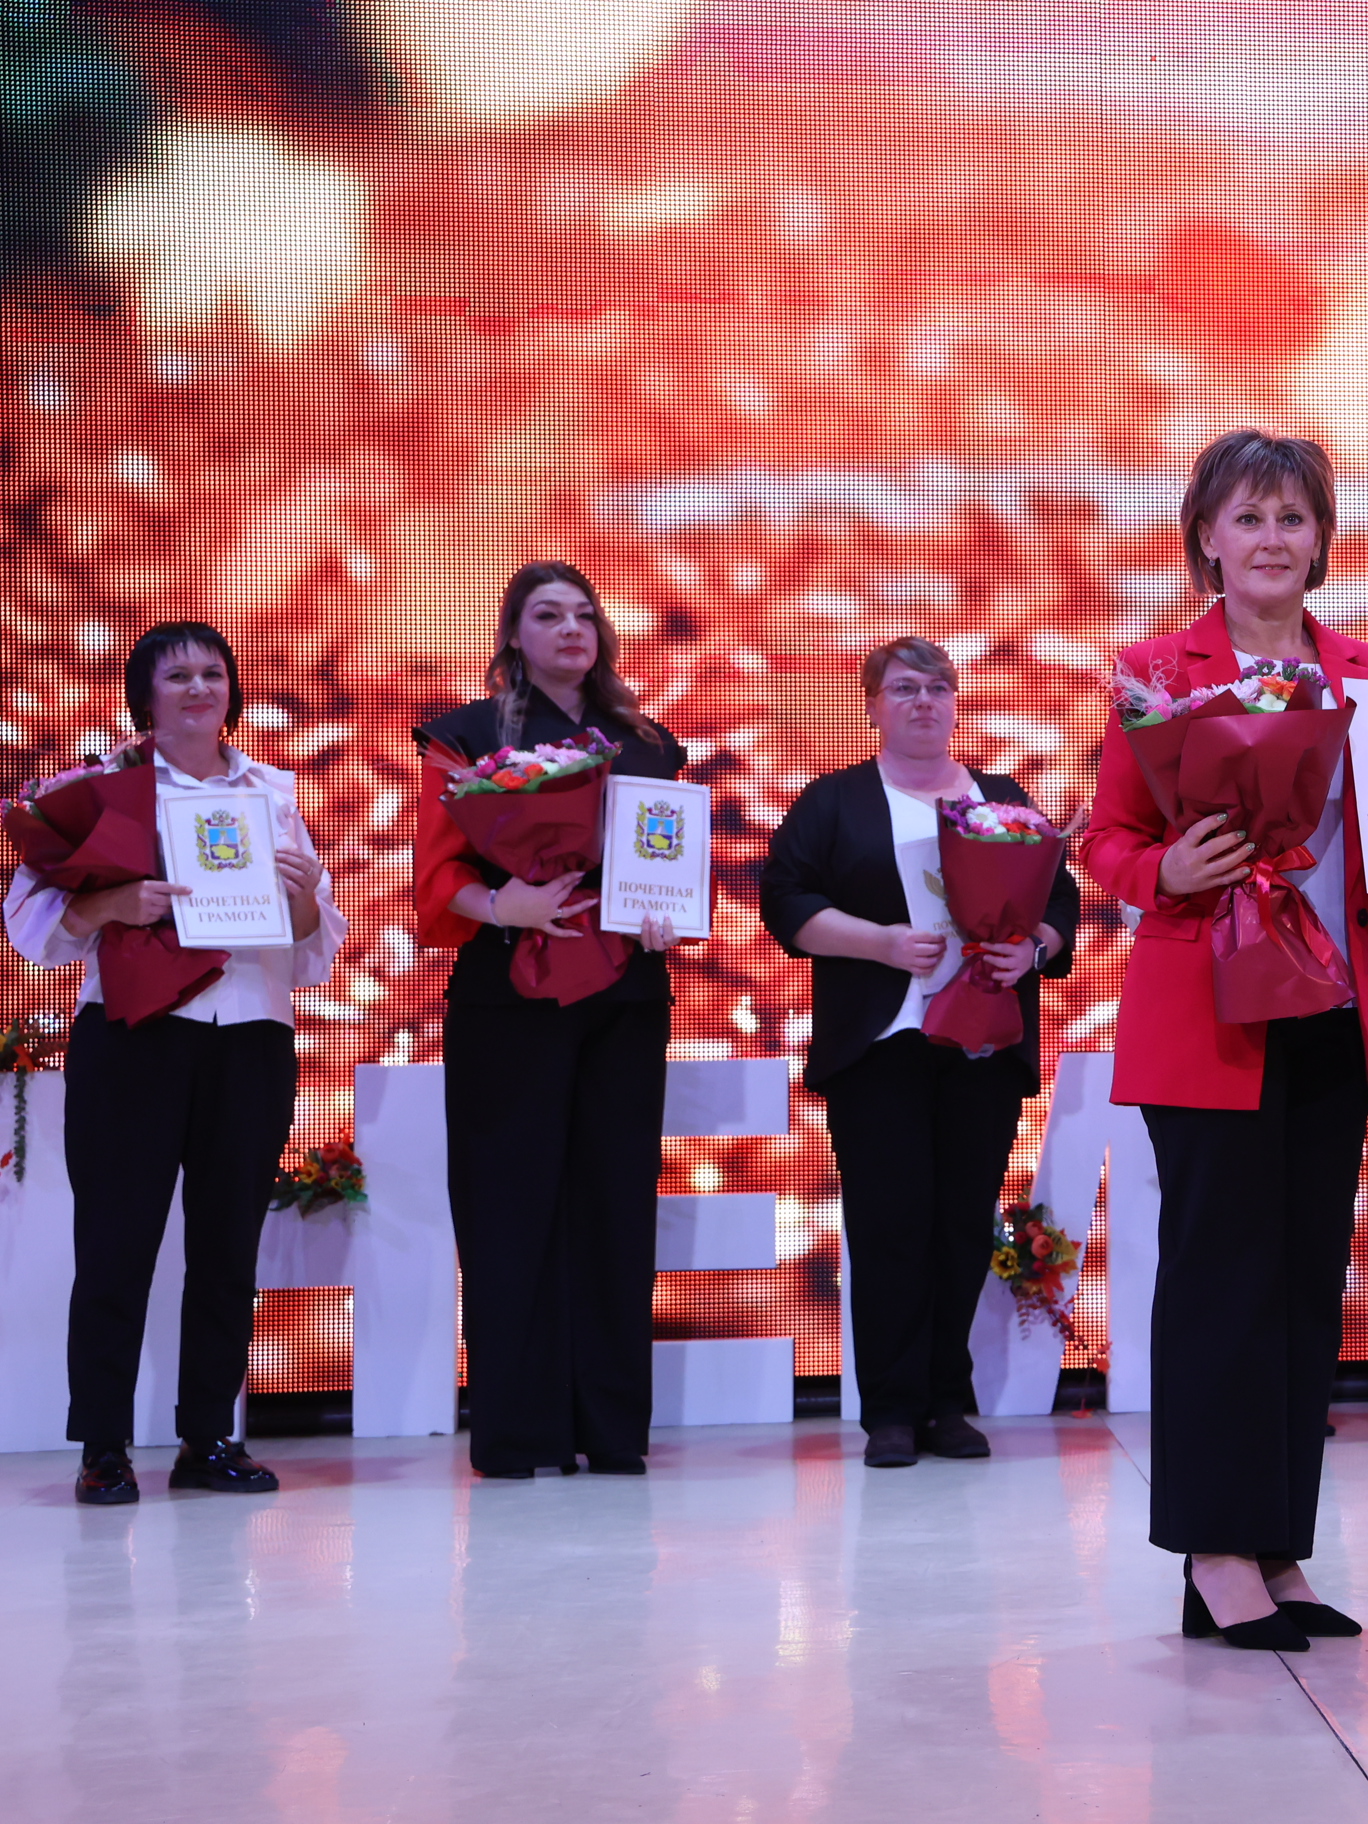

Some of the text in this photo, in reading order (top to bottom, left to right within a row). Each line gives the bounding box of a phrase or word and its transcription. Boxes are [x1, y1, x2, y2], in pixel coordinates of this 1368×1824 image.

[618, 881, 694, 899] ПОЧЕТНАЯ
[188, 894, 271, 908] ПОЧЕТНАЯ
[623, 897, 687, 913] ГРАМОТА
[198, 910, 267, 922] ГРАМОТА
